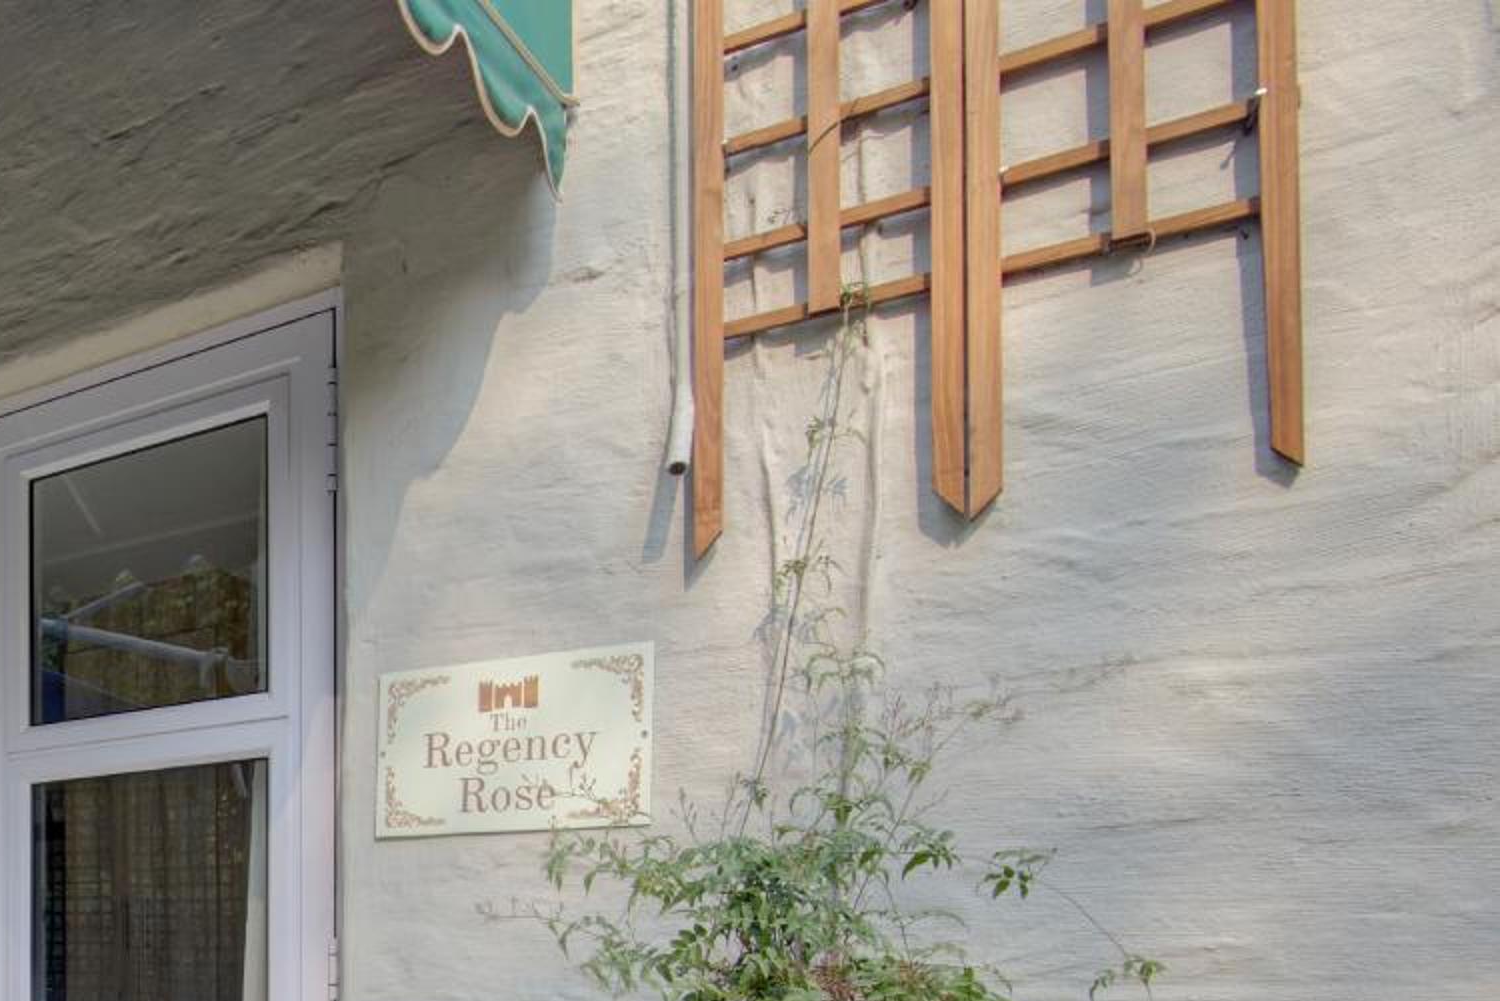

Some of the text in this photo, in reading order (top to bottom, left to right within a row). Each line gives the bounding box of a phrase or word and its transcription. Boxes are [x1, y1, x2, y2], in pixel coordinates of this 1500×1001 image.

[490, 713, 527, 732] The
[423, 731, 596, 775] Regency
[461, 777, 554, 813] Rose
